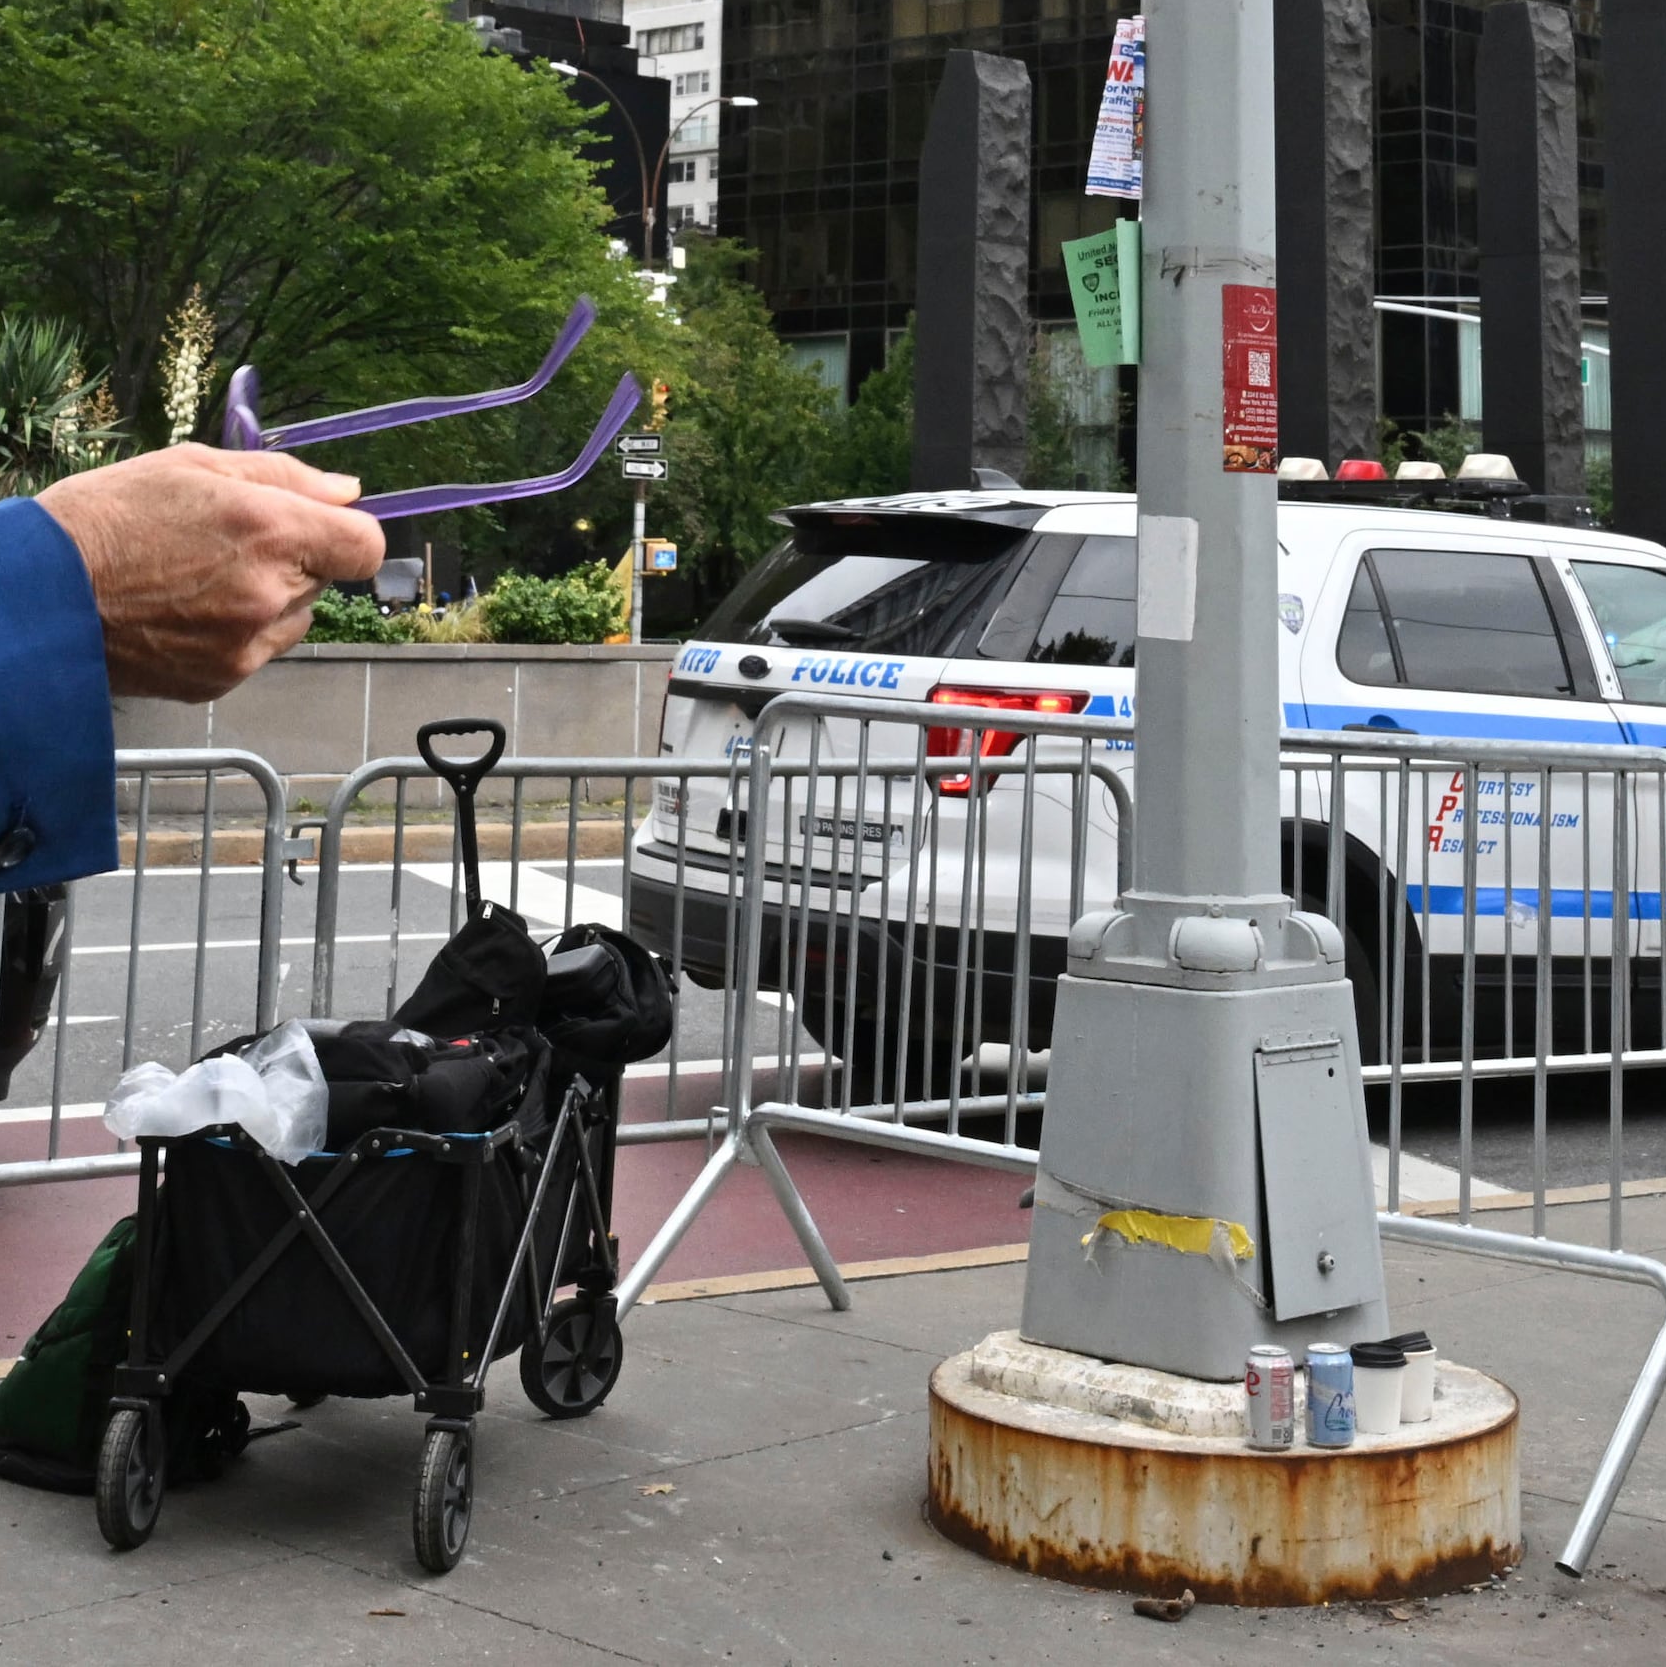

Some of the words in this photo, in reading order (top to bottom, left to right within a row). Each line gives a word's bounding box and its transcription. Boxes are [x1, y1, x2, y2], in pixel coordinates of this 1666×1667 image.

[1078, 243, 1106, 261] United
[1088, 307, 1114, 318] Friday
[679, 647, 721, 674] NYPD
[791, 656, 905, 689] POLICE
